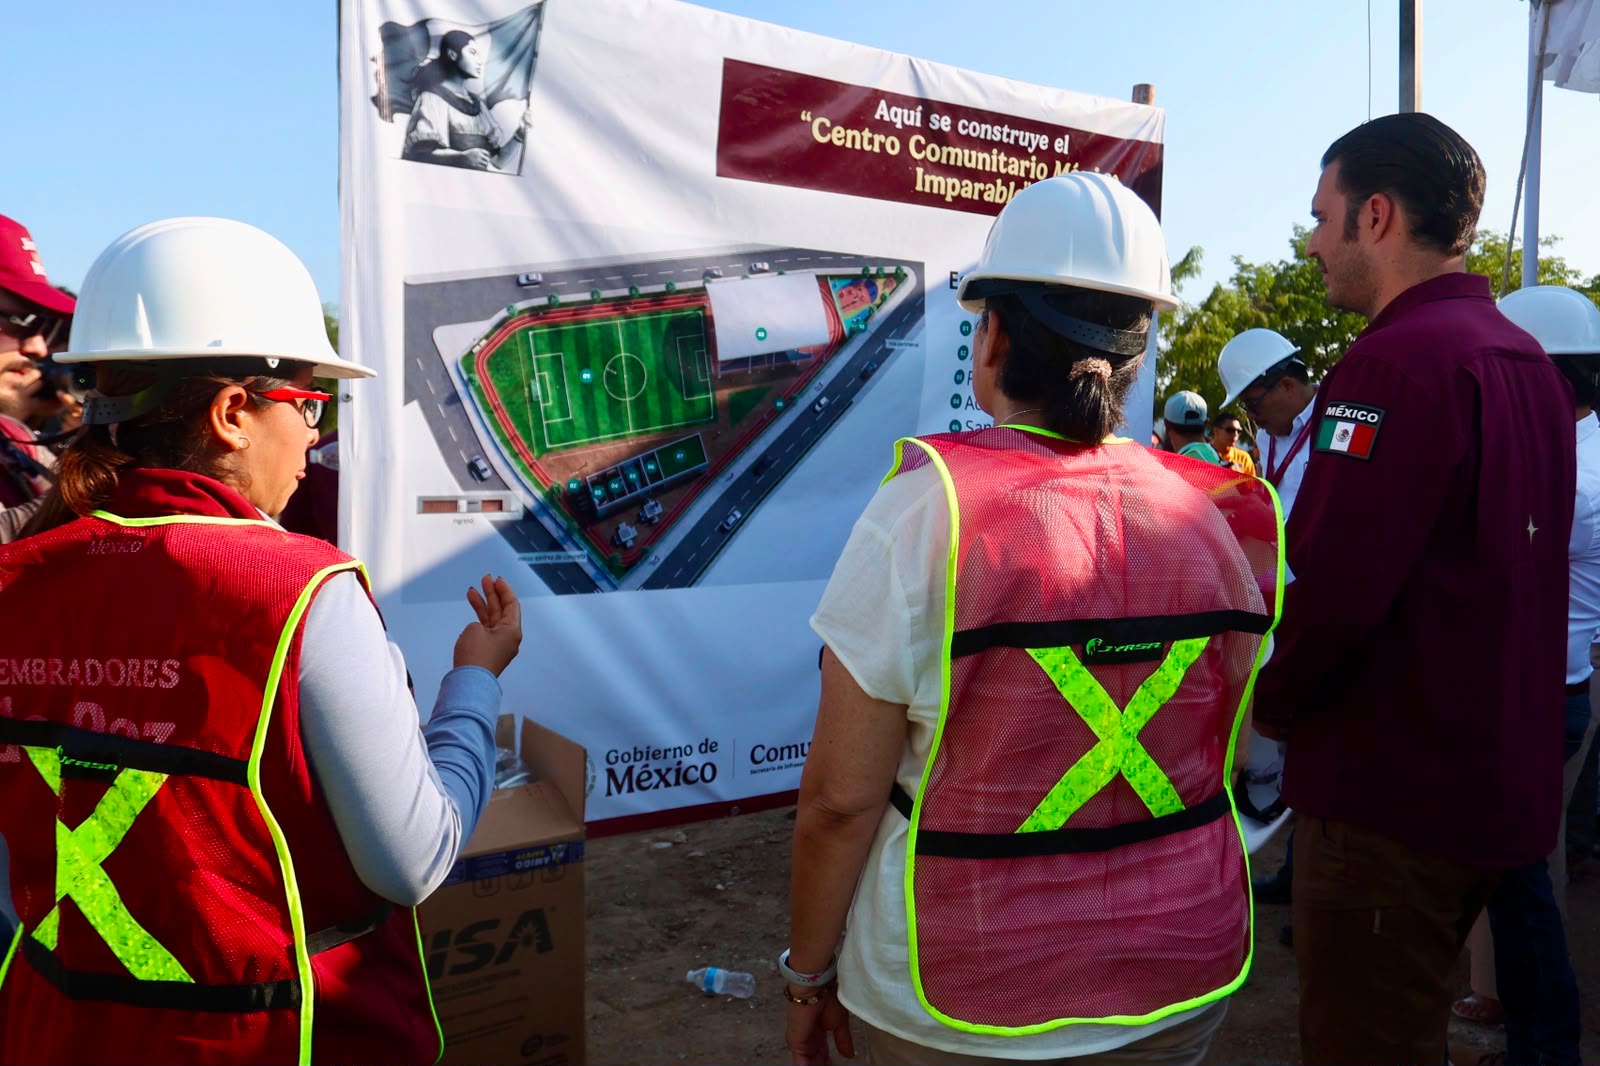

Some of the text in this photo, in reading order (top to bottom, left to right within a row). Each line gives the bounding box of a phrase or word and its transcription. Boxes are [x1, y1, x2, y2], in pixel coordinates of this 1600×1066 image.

[875, 99, 1070, 155] Aquí se construye el
[909, 134, 1049, 180] Comunitario
[1325, 405, 1379, 423] MÉXICO
[605, 738, 718, 766] Gobierno de
[605, 760, 717, 797] México
[429, 907, 554, 980] ISA
